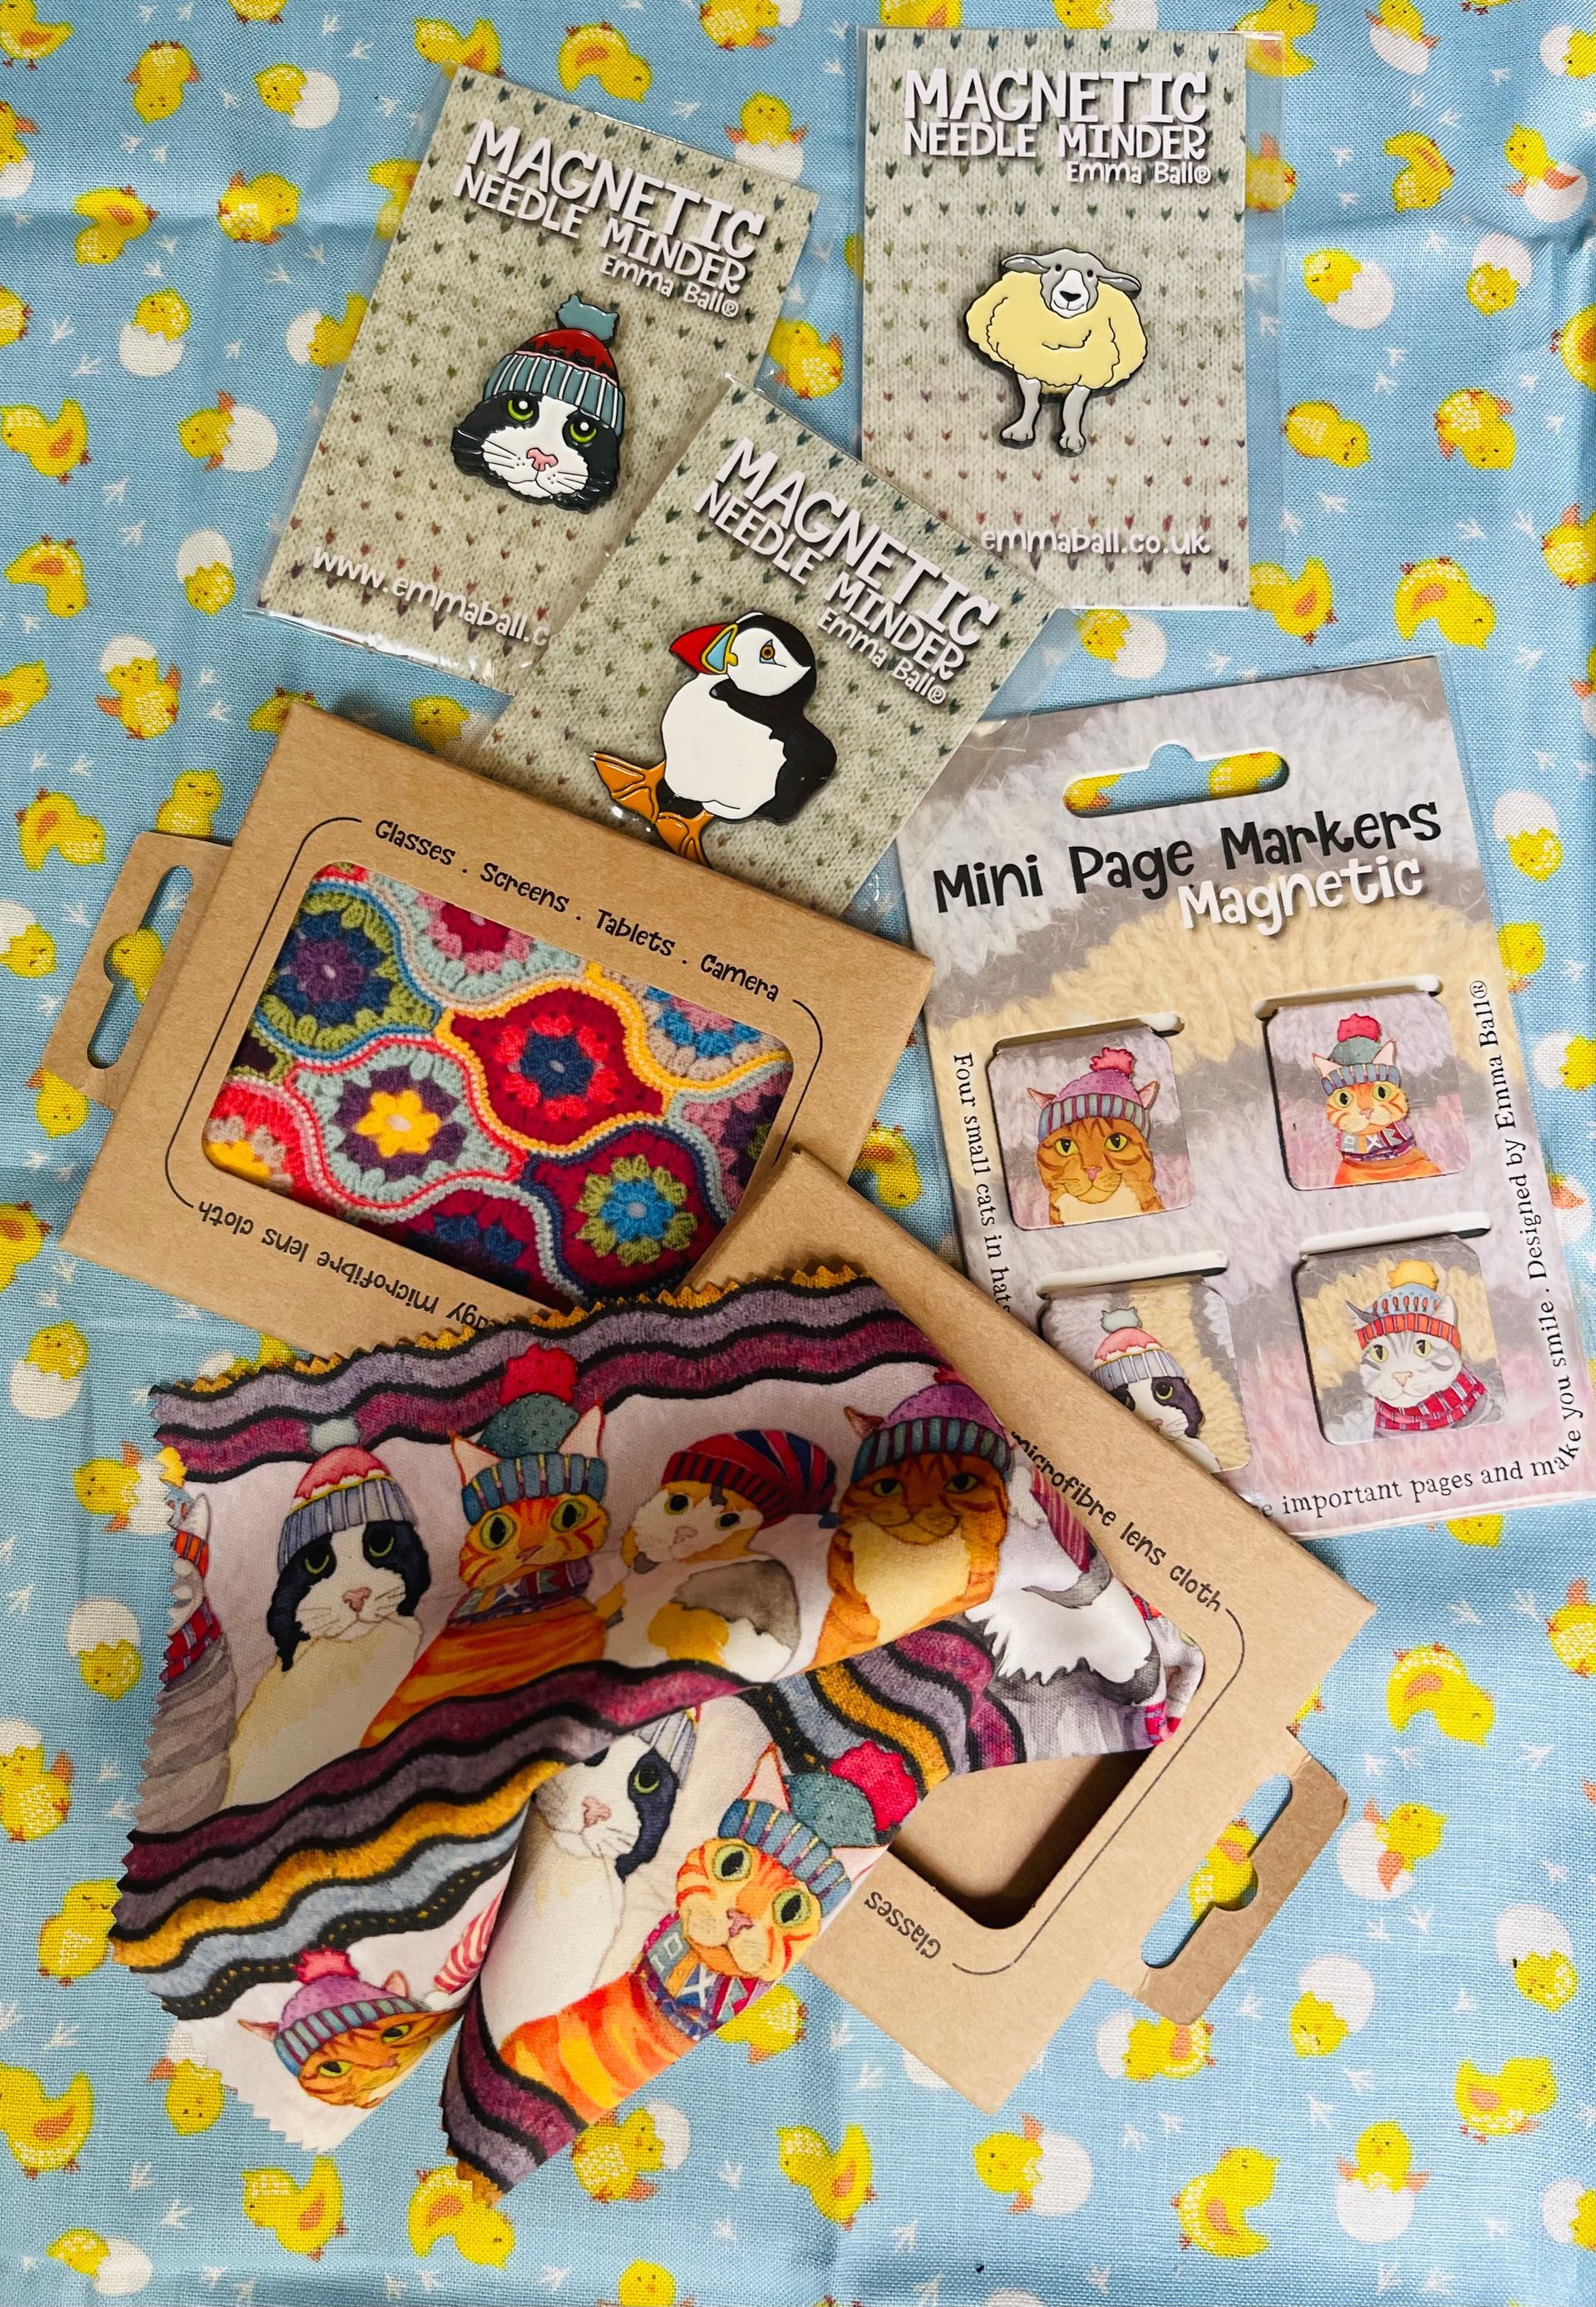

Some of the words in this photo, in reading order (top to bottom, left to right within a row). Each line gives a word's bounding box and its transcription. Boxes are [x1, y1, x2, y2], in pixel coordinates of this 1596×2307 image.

[904, 68, 1206, 123] MAGNETIC
[904, 121, 1037, 157] NEEDLE
[1058, 124, 1206, 160] MINDER
[466, 118, 765, 259] MAGNETIC
[1066, 160, 1142, 185] Emma
[454, 165, 589, 239] NEEDLE
[600, 218, 746, 293] MINDER
[600, 254, 673, 297] Emma
[716, 436, 998, 646] MAGNETIC
[981, 528, 1211, 555] emmaball.co.uk
[313, 546, 554, 647] www.emmaball.c
[692, 481, 823, 585] NEEDLE
[824, 573, 964, 681] MINDER
[816, 607, 889, 668] Emma
[933, 854, 1043, 914] Mini
[1068, 840, 1195, 901] Page
[1219, 801, 1441, 870] Markers
[375, 820, 456, 866] Glasses
[480, 862, 569, 913] Screens
[593, 909, 675, 957] Tablets
[699, 954, 780, 1002] Camera
[1177, 854, 1423, 937] Magnetic
[954, 1052, 976, 1107] Four
[1490, 1054, 1515, 1129] Emma
[964, 1116, 991, 1176] small
[1505, 1139, 1526, 1166] by
[198, 1200, 254, 1235] cloth
[976, 1183, 996, 1227] cats
[1509, 1174, 1546, 1279] Designed
[261, 1227, 310, 1263] lens
[984, 1235, 1002, 1259] in
[317, 1250, 440, 1314] microfibre
[1539, 1300, 1566, 1368] smile
[1558, 1375, 1584, 1419] you
[1480, 1462, 1523, 1484] and
[1530, 1430, 1581, 1476] make
[1282, 1480, 1402, 1518] important
[1411, 1474, 1473, 1503] pages
[1120, 1521, 1166, 1565] lens
[1170, 1565, 1220, 1612] cloth
[864, 1891, 941, 1959] Glasses
